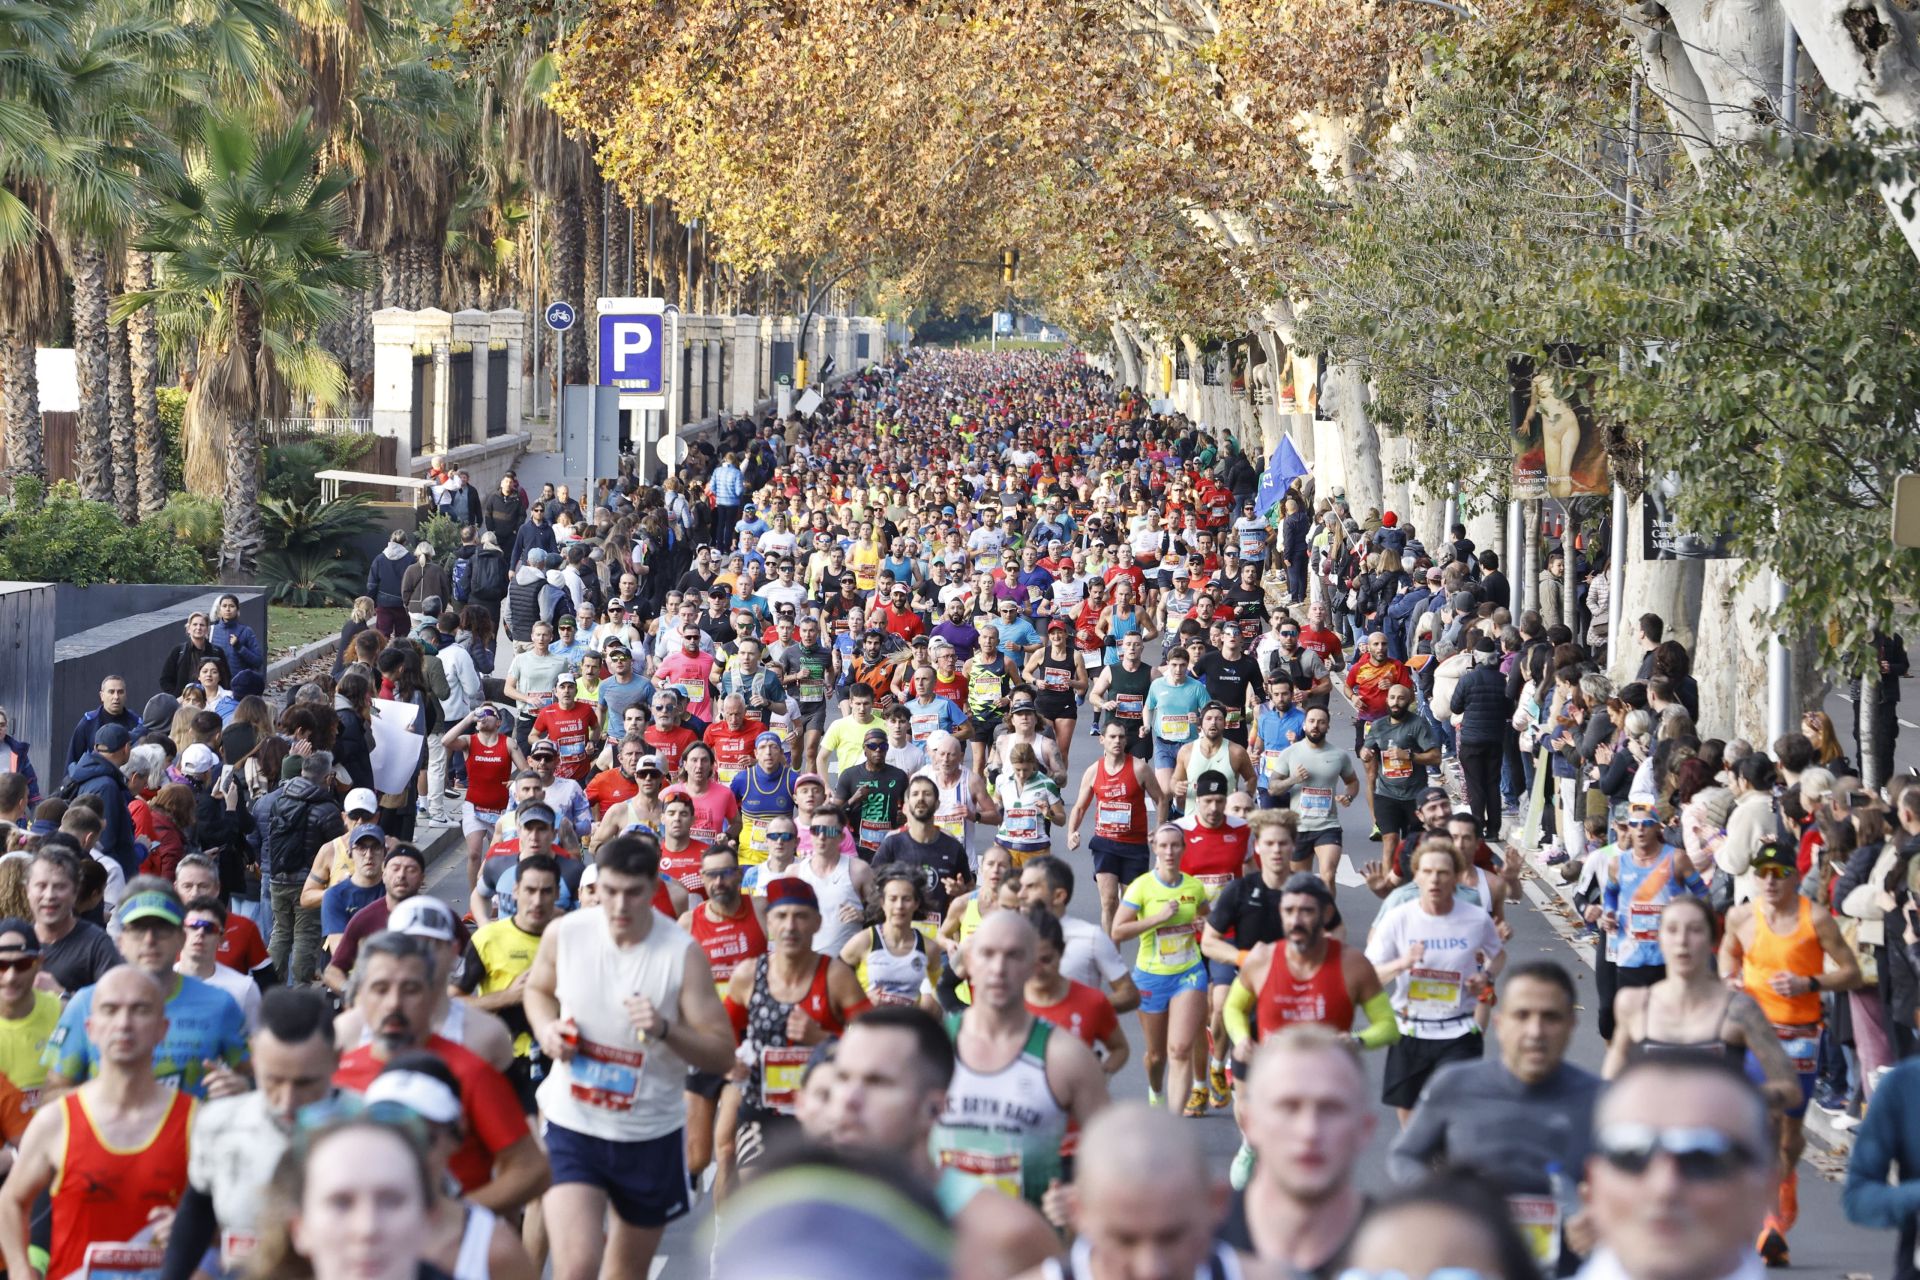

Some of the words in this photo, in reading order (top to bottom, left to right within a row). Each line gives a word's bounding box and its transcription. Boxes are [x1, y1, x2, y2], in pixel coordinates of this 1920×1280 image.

[613, 322, 652, 372] P
[1518, 476, 1545, 484] Carmen
[475, 755, 502, 763] DENMARK
[866, 793, 885, 822] ARIS
